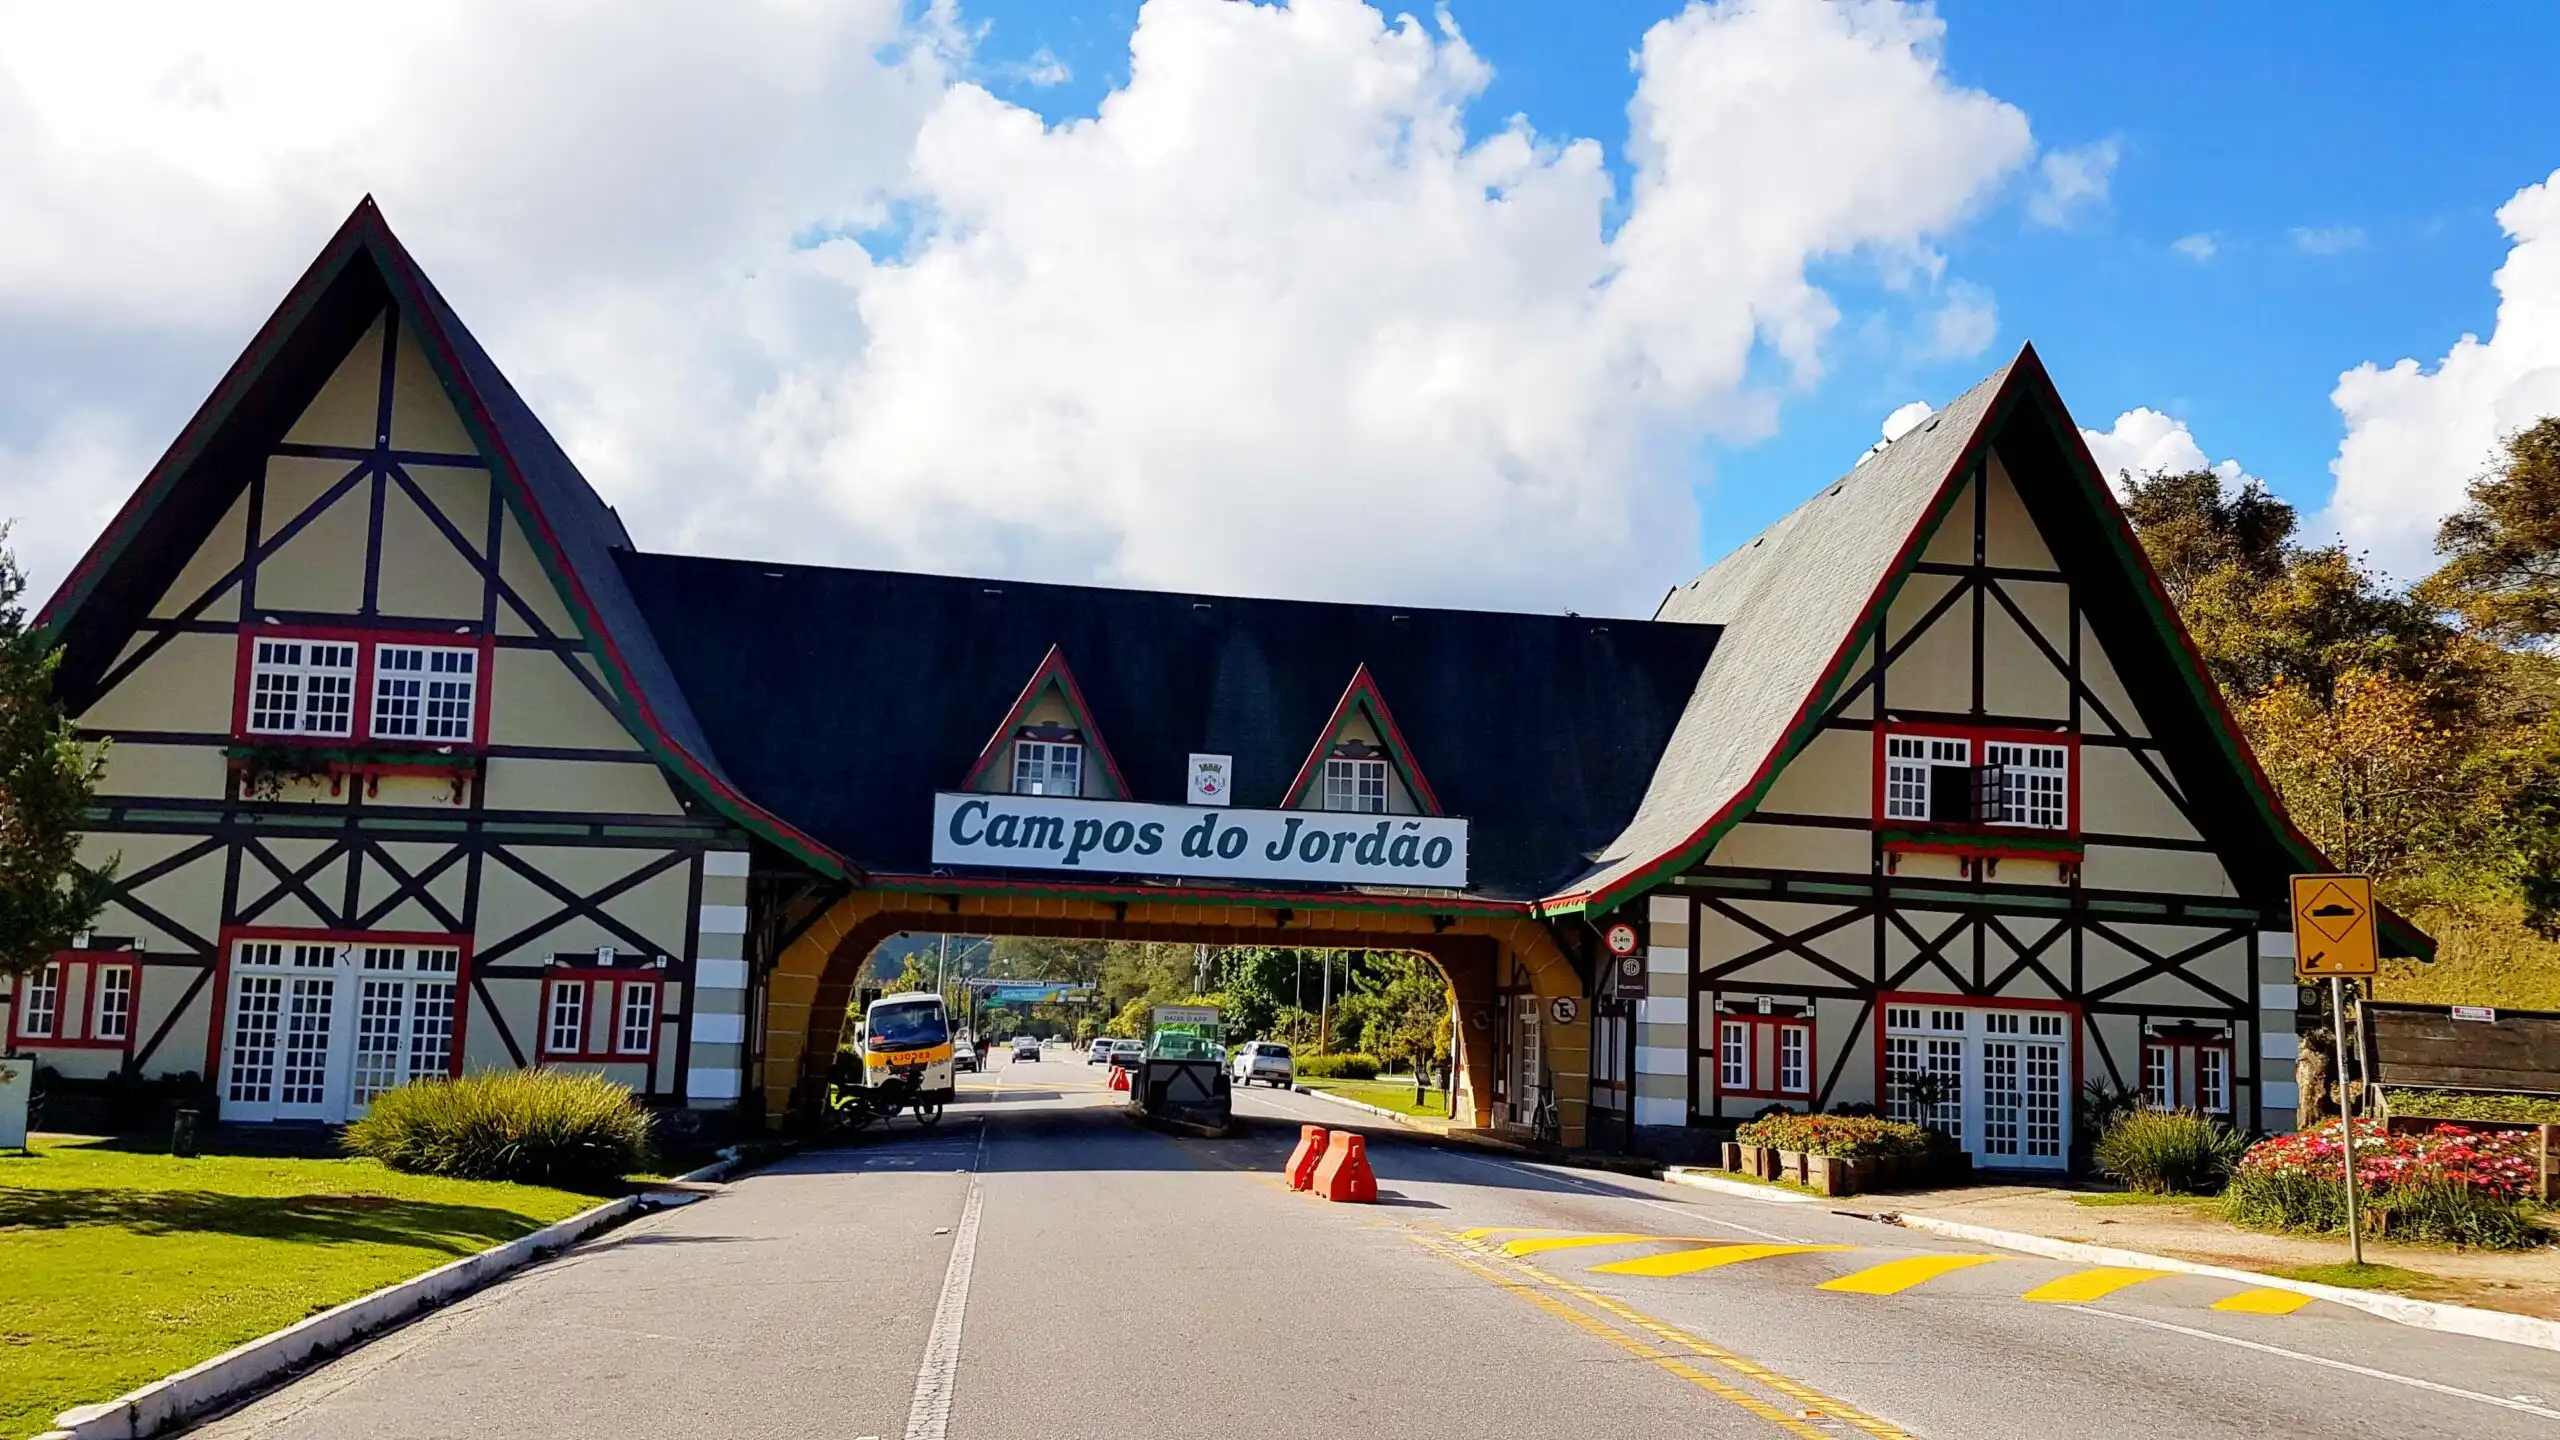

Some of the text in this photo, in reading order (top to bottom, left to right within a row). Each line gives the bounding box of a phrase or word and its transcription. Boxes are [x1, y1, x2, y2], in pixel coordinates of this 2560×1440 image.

[949, 800, 1453, 869] Campos do Jordão
